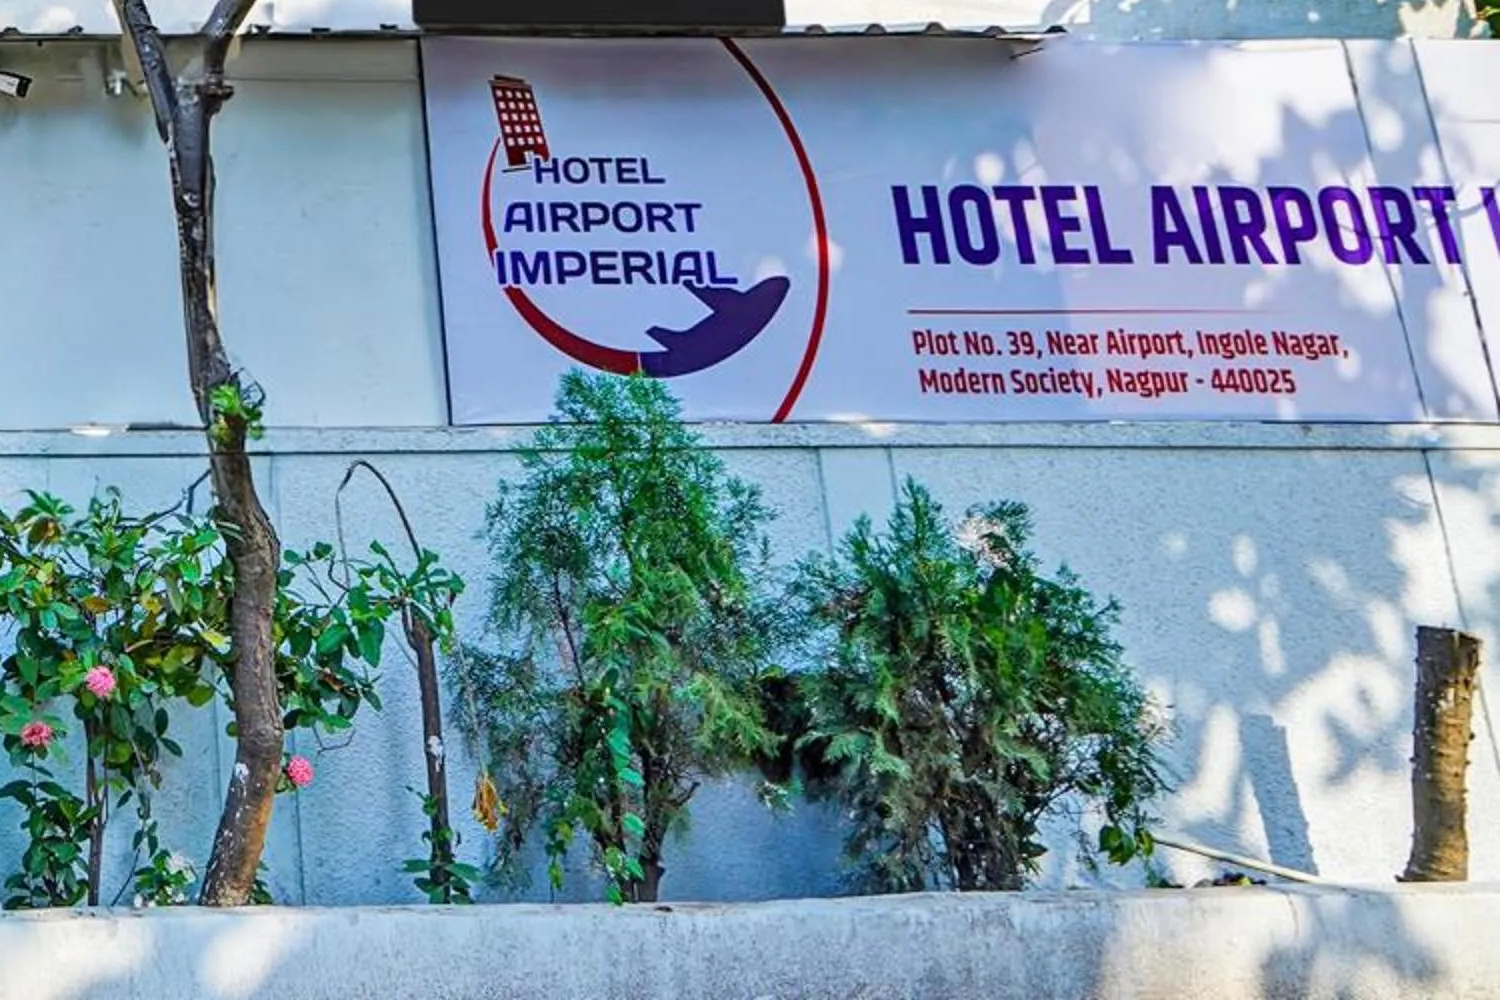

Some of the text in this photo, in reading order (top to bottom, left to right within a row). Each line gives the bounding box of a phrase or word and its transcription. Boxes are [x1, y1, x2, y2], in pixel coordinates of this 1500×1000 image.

[534, 157, 666, 185] HOTEL
[503, 202, 703, 234] AIRPORT
[891, 185, 1134, 265] HOTEL
[1150, 185, 1462, 265] AIRPORT
[496, 250, 739, 286] IMPERIAL
[912, 329, 1349, 361] Plot No. 39, Near Airport, Ingole Nagar,
[919, 368, 1006, 394] Modern
[1009, 368, 1103, 399] Society,
[1106, 368, 1188, 397] Nagpur
[1211, 369, 1296, 393] 440025
